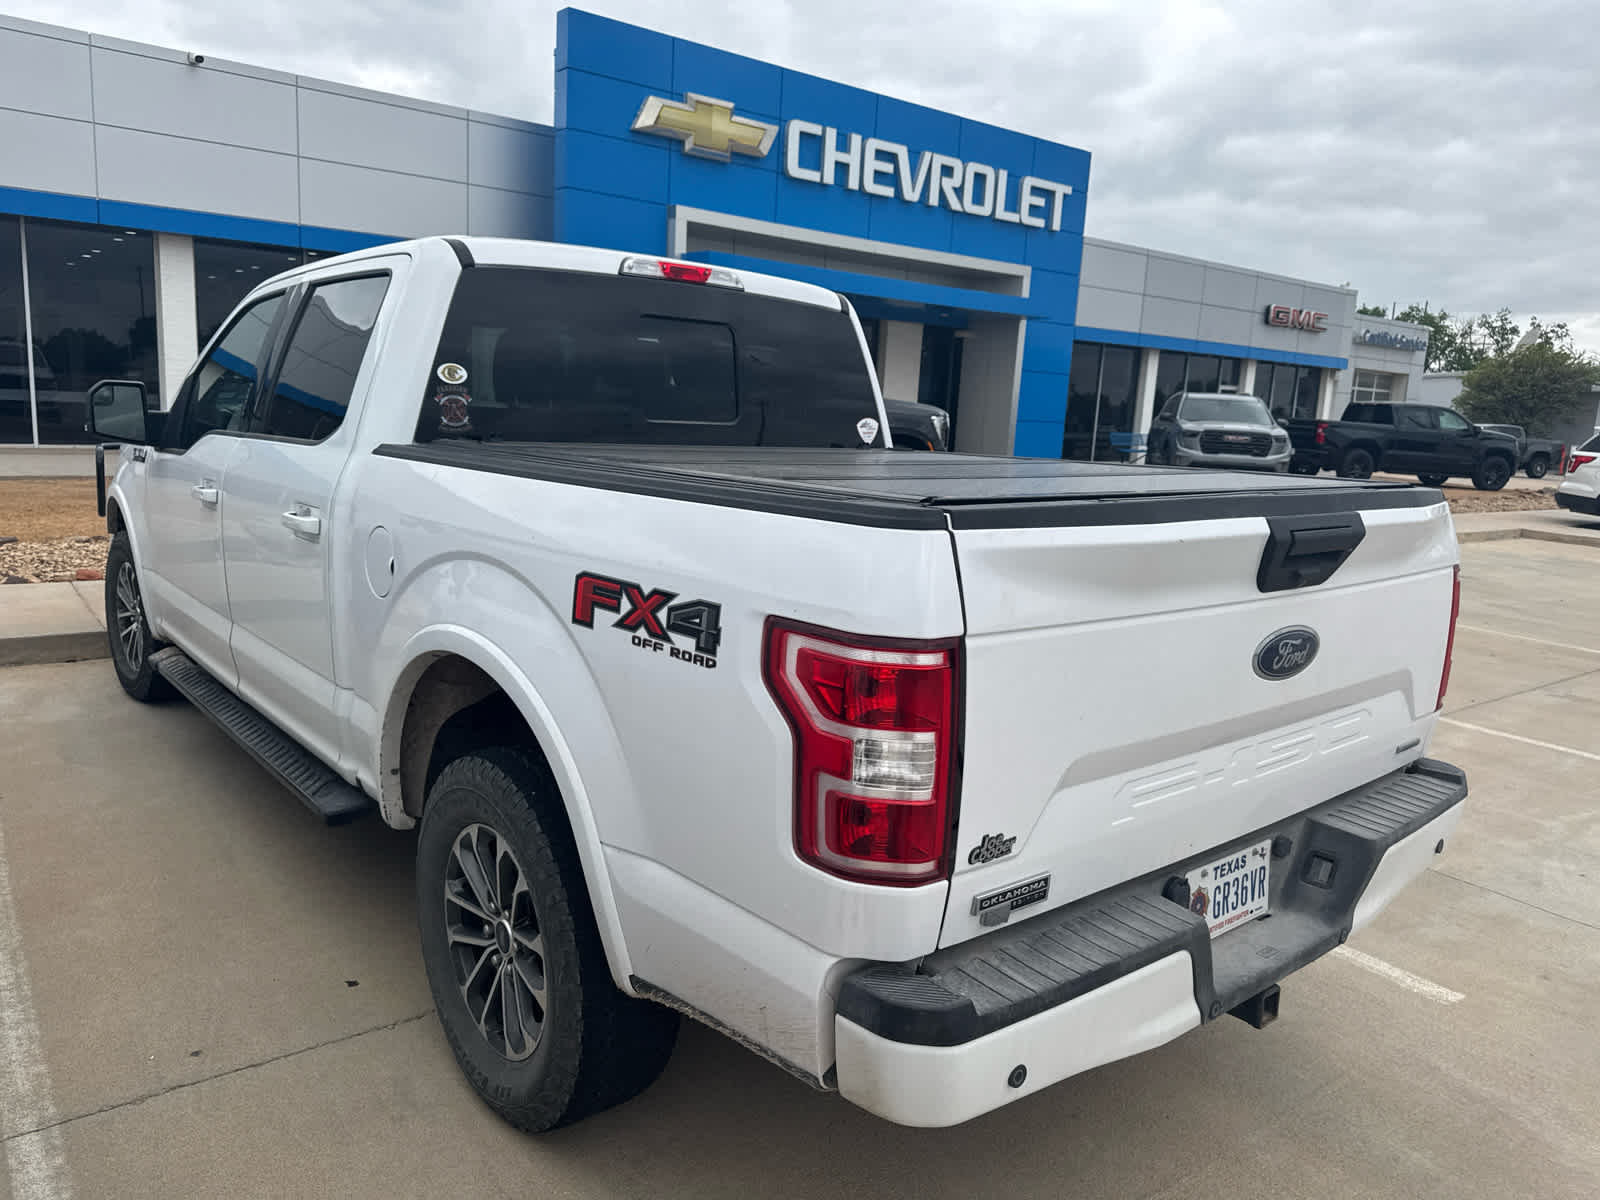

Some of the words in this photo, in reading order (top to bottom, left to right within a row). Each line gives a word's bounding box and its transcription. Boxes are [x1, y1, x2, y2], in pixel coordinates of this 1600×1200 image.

[786, 119, 1072, 231] CHEVROLET
[1269, 305, 1328, 333] GMC
[572, 570, 722, 658] FX4
[631, 635, 664, 652] OFF
[669, 646, 717, 669] ROAD
[1273, 639, 1310, 670] Ford
[1213, 855, 1247, 880] TEXAS
[982, 880, 1046, 908] OKLAHOMA
[1212, 866, 1266, 919] GR36VR
